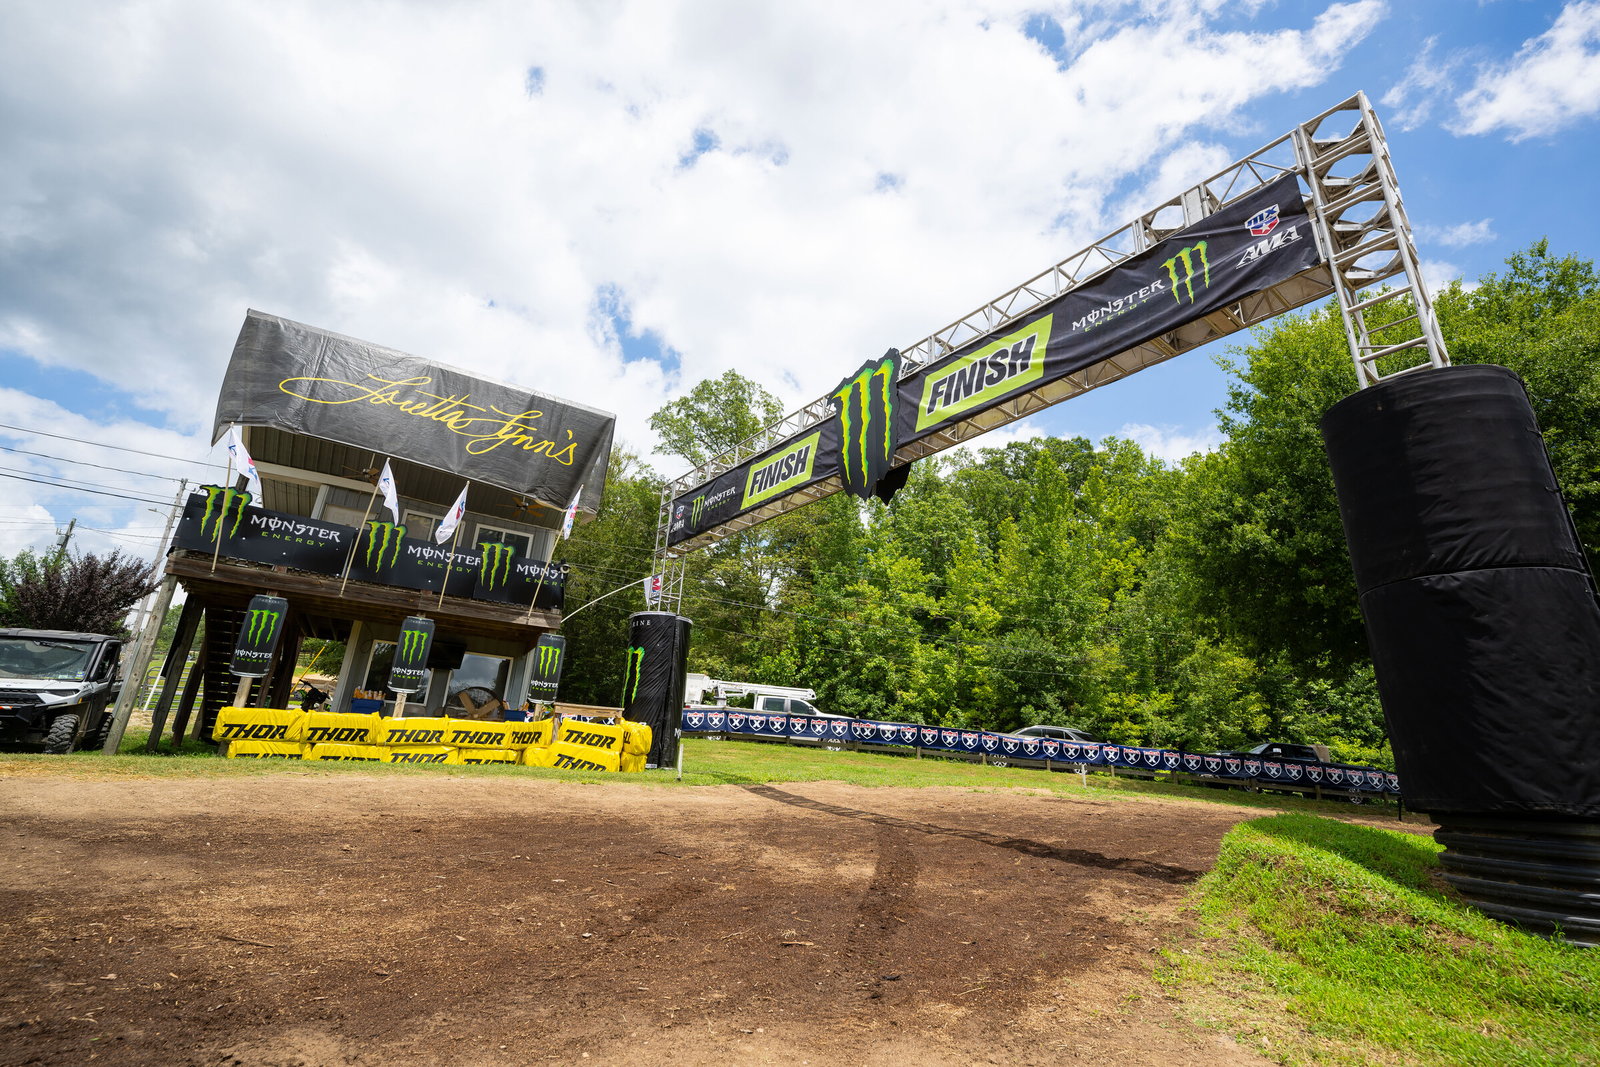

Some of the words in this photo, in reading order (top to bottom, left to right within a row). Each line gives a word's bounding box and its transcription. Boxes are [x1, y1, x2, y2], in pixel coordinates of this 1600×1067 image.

[1072, 280, 1166, 330] MONSTER
[1084, 298, 1148, 332] ENERGY
[926, 332, 1038, 416] FINISH
[279, 374, 487, 429] Loretta
[452, 405, 577, 466] Lynn's
[748, 444, 812, 498] FINISH
[704, 486, 736, 507] MONSTER
[250, 514, 340, 543] MONSTER
[261, 531, 326, 548] ENERGY
[221, 724, 288, 740] THOR
[306, 727, 370, 742] THOR
[385, 730, 445, 743] THOR
[450, 730, 506, 746] THOR
[563, 729, 616, 750] THOR
